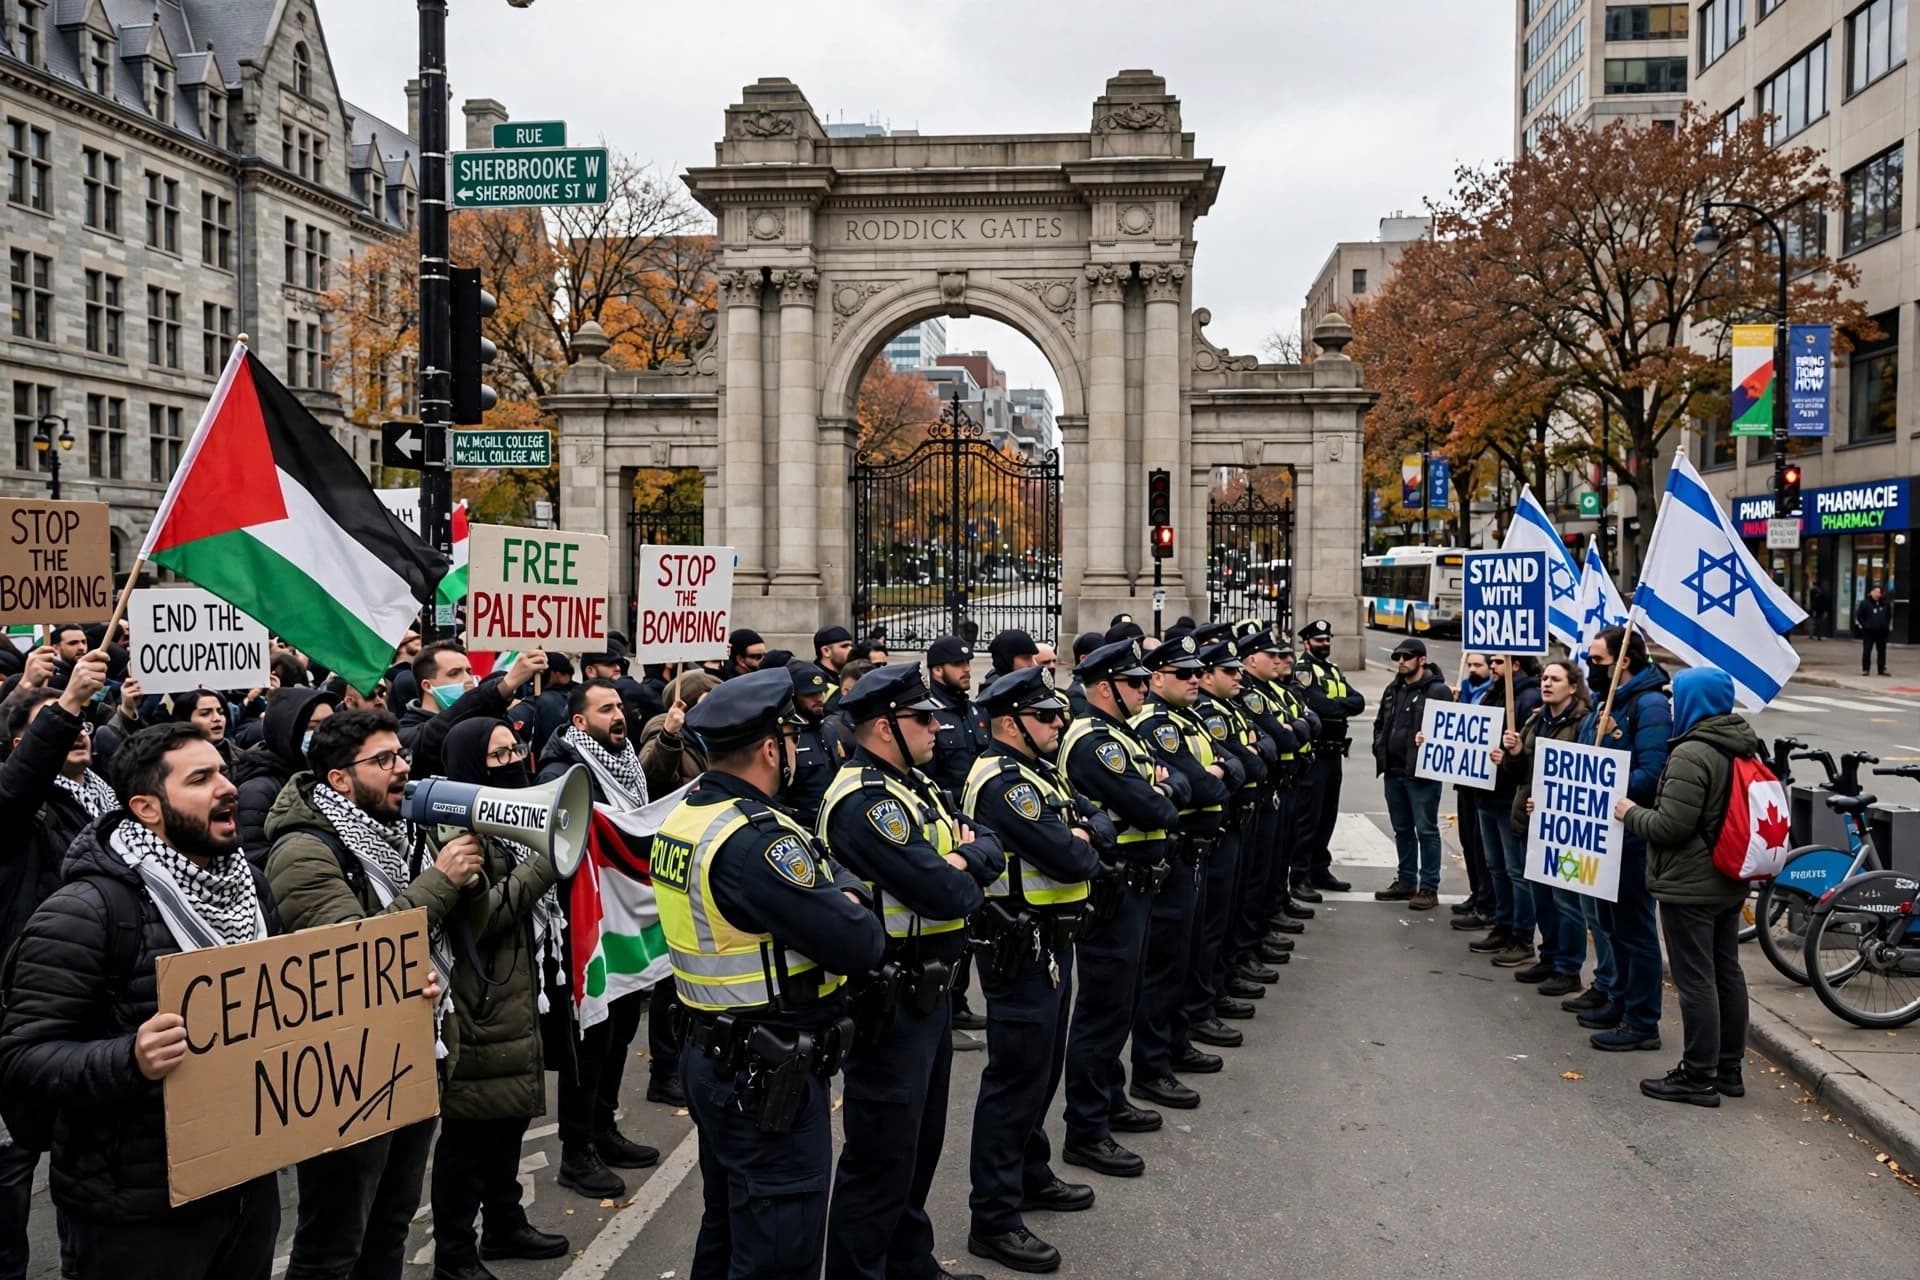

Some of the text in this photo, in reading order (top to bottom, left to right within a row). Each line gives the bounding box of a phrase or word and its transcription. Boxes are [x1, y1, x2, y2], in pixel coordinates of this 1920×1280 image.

[516, 128, 543, 144] RUE
[460, 156, 600, 182] SHERBROOKE W
[475, 183, 597, 201] SHERBROOKE ST W
[846, 216, 1062, 240] RODDICK GATES
[456, 435, 545, 448] AV. McGILL COLLEGE
[456, 450, 546, 463] McGILL COLLEGE AVE
[1817, 485, 1898, 513] PHARMACIE
[11, 508, 80, 544] STOP
[1821, 510, 1885, 530] PHARMACY
[29, 549, 68, 571] THE
[503, 538, 579, 585] FREE
[657, 554, 716, 587] STOP
[1470, 557, 1539, 584] STAND
[0, 575, 107, 611] BOMBING
[675, 590, 697, 606] THE
[1481, 586, 1522, 606] WITH
[153, 604, 243, 632] END THE
[473, 591, 605, 639] PALESTINE
[642, 610, 726, 644] BOMBING
[1468, 609, 1540, 646] ISRAEL
[140, 642, 261, 674] OCCUPATION
[1433, 711, 1491, 745] PEACE
[1423, 742, 1489, 780] FOR ALL
[1543, 747, 1617, 788] BRING
[478, 800, 548, 830] PALESTINE
[1543, 780, 1609, 820] THEM
[1539, 812, 1609, 855] HOME
[651, 837, 690, 884] POLICE
[180, 930, 423, 1055] CEASEFIRE
[254, 1027, 369, 1137] NOW
